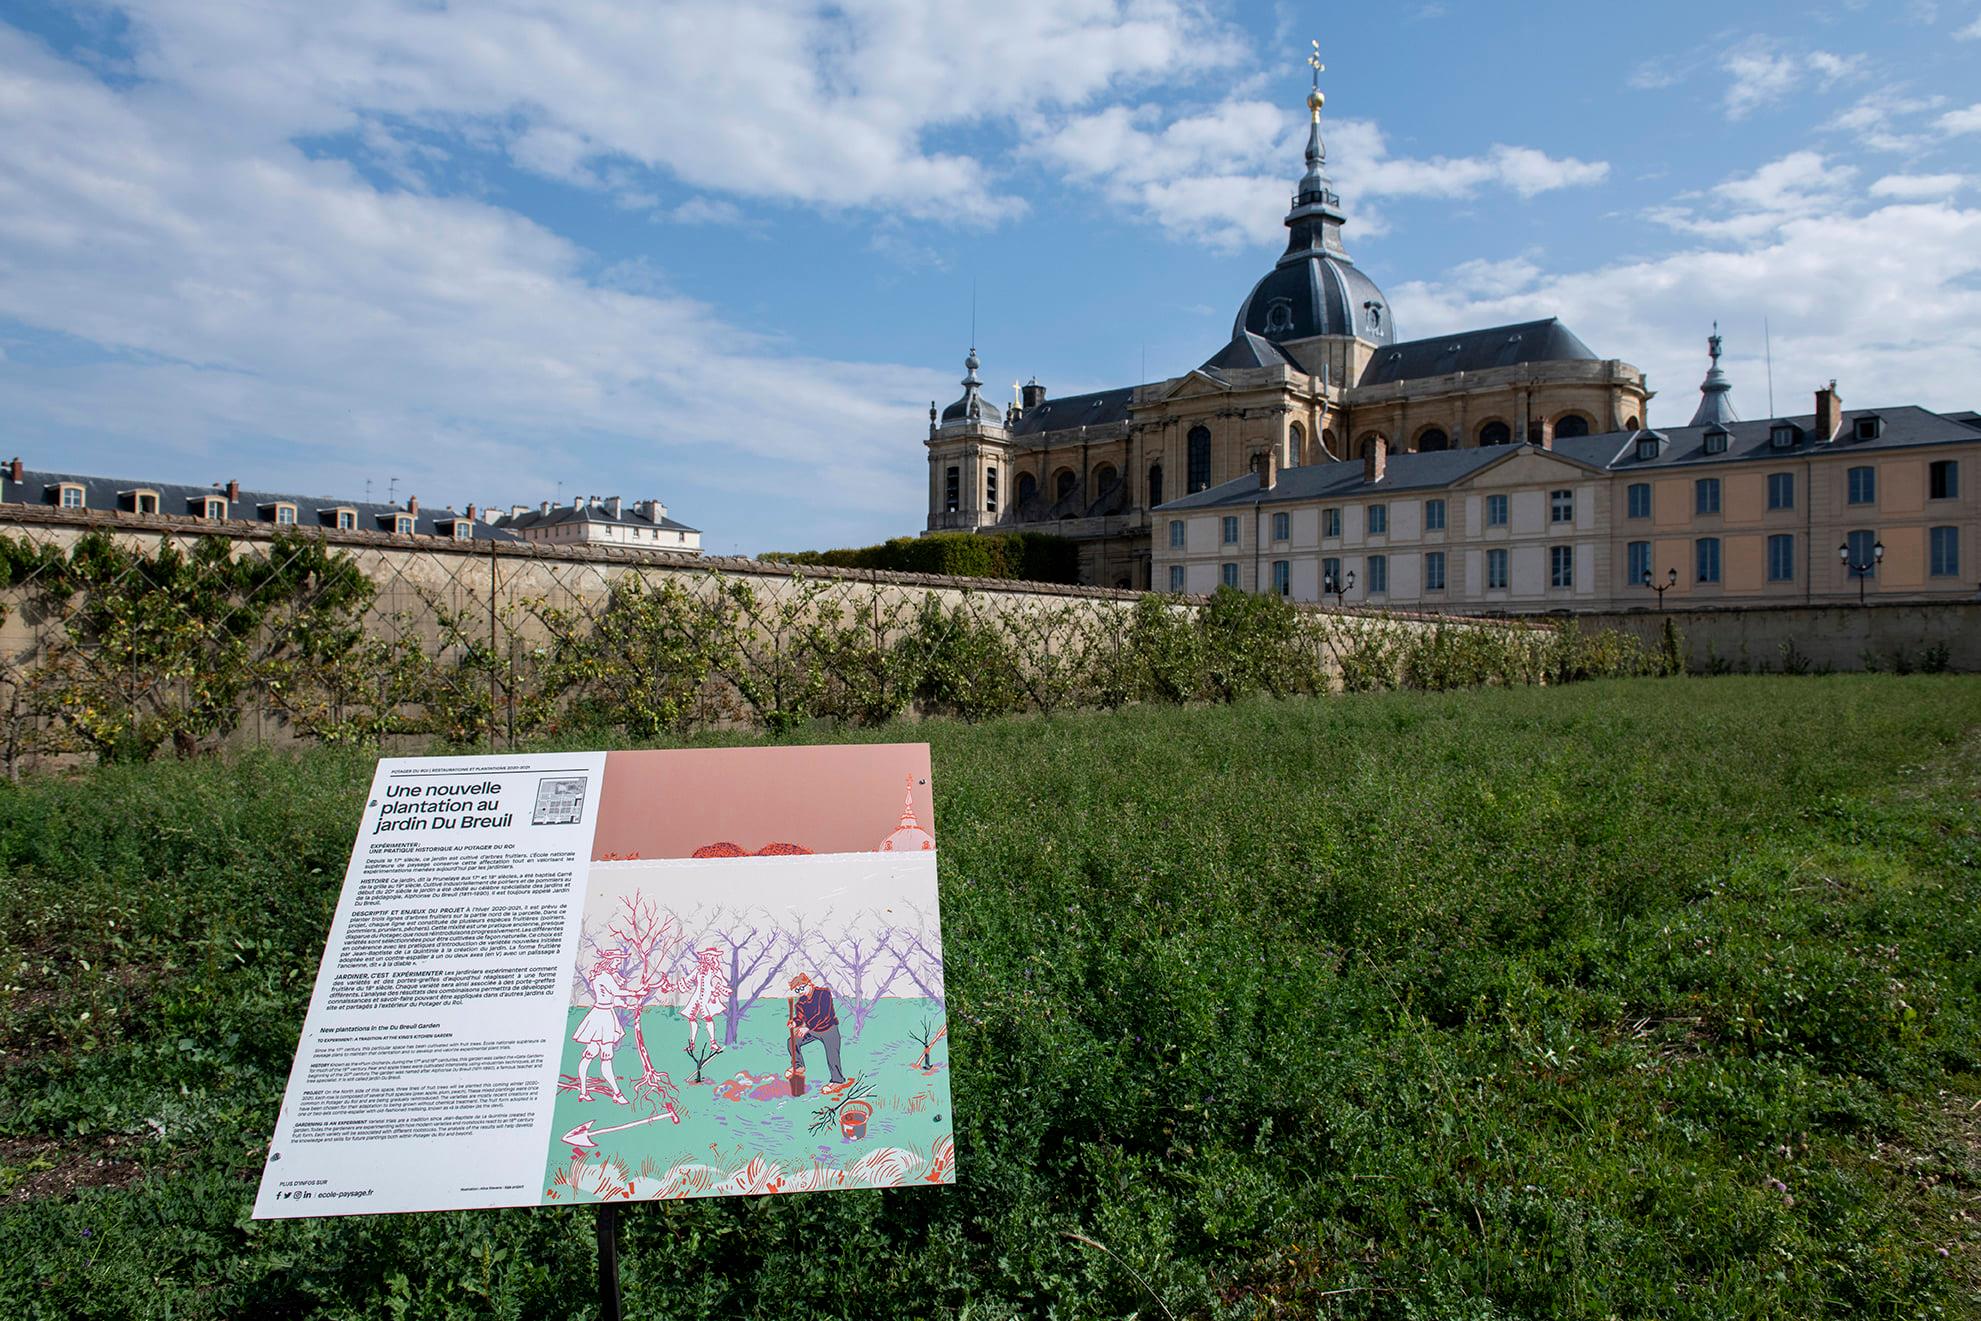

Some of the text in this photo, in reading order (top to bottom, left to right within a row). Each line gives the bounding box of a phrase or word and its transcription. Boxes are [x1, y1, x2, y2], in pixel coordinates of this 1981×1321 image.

[386, 782, 501, 797] Une nouvelle
[380, 799, 499, 816] plantation au
[372, 814, 513, 834] jardin Du Breuil
[318, 1190, 374, 1198] ecole-paysage.fr
